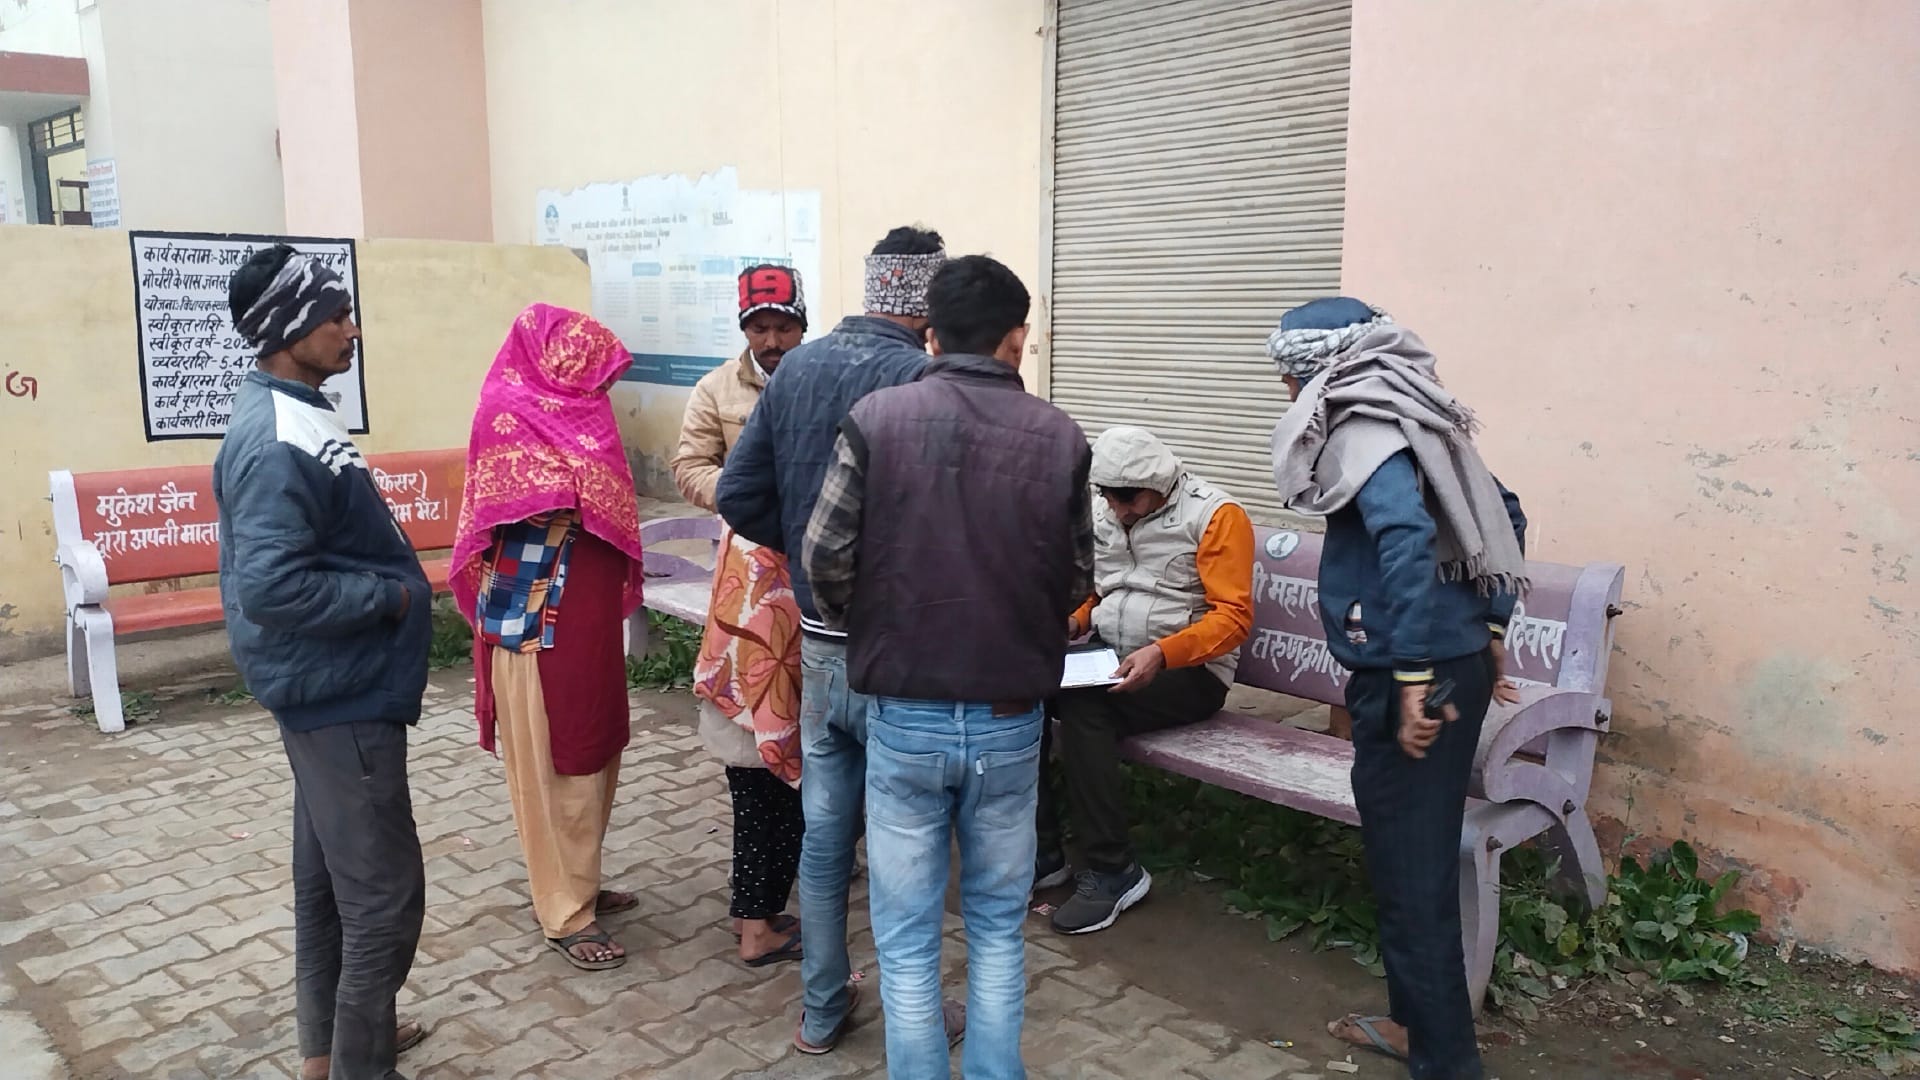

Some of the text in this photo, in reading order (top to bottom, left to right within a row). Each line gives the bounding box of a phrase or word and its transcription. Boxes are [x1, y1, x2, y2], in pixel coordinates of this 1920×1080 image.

[144, 241, 173, 263] कार्य
[171, 247, 189, 264] का
[173, 267, 183, 289] के
[183, 274, 203, 290] पास
[212, 300, 230, 312] स्था
[148, 312, 196, 336] स्वीकृत
[149, 332, 195, 355] स्वीकृत
[152, 370, 181, 389] कार्य
[154, 390, 181, 409] कार्य
[182, 390, 204, 412] पूर्ण
[205, 411, 231, 427] विभा
[96, 467, 428, 527] मुकेश जैन फिसर)
[94, 530, 128, 560] द्वारा
[129, 518, 180, 550] अपनी
[1503, 600, 1567, 670] दिवस
